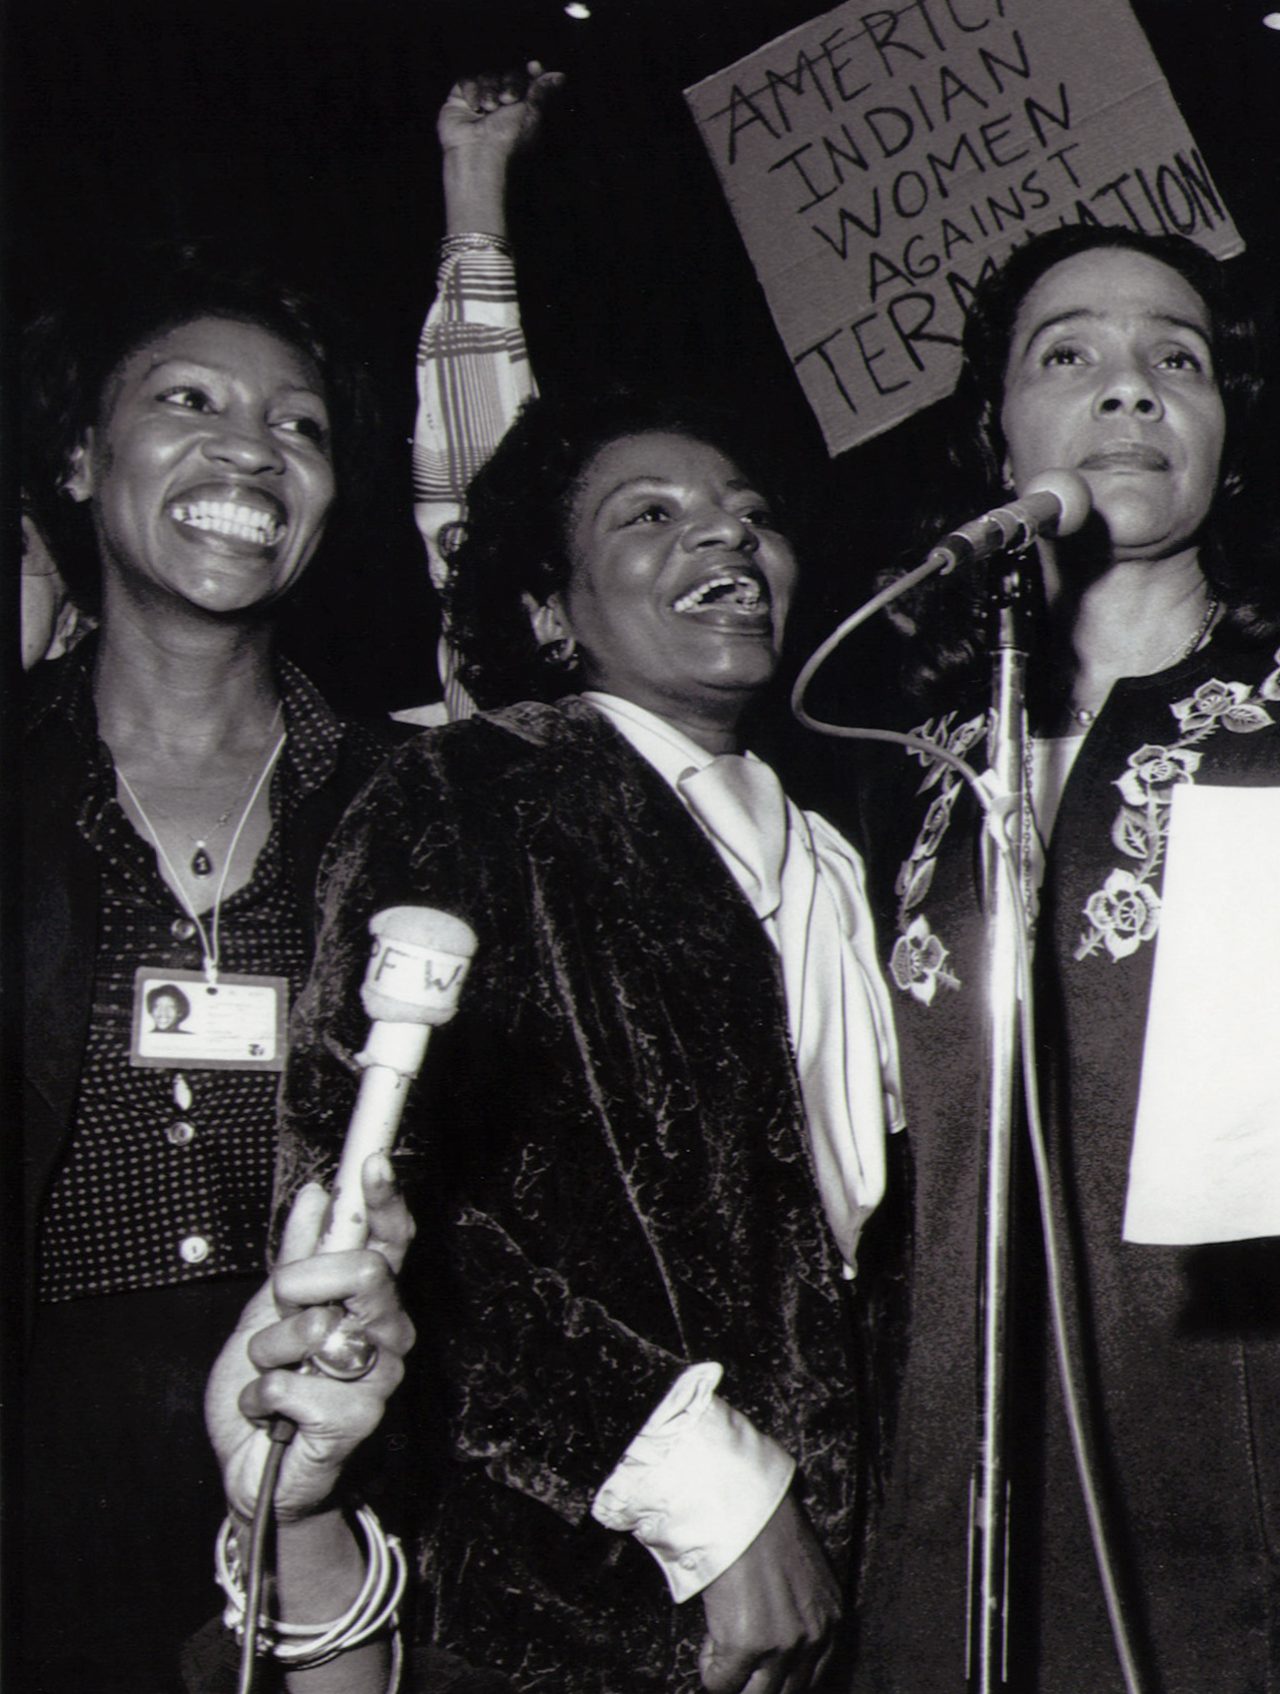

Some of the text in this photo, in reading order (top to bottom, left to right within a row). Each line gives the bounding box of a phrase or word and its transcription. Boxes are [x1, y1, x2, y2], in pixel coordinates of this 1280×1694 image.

[726, 0, 1004, 165] AMERIC
[767, 30, 1031, 213] INDIAN
[812, 82, 1072, 260] WOMEN
[794, 148, 1225, 414] TERMTION
[869, 143, 1080, 302] AGAINST
